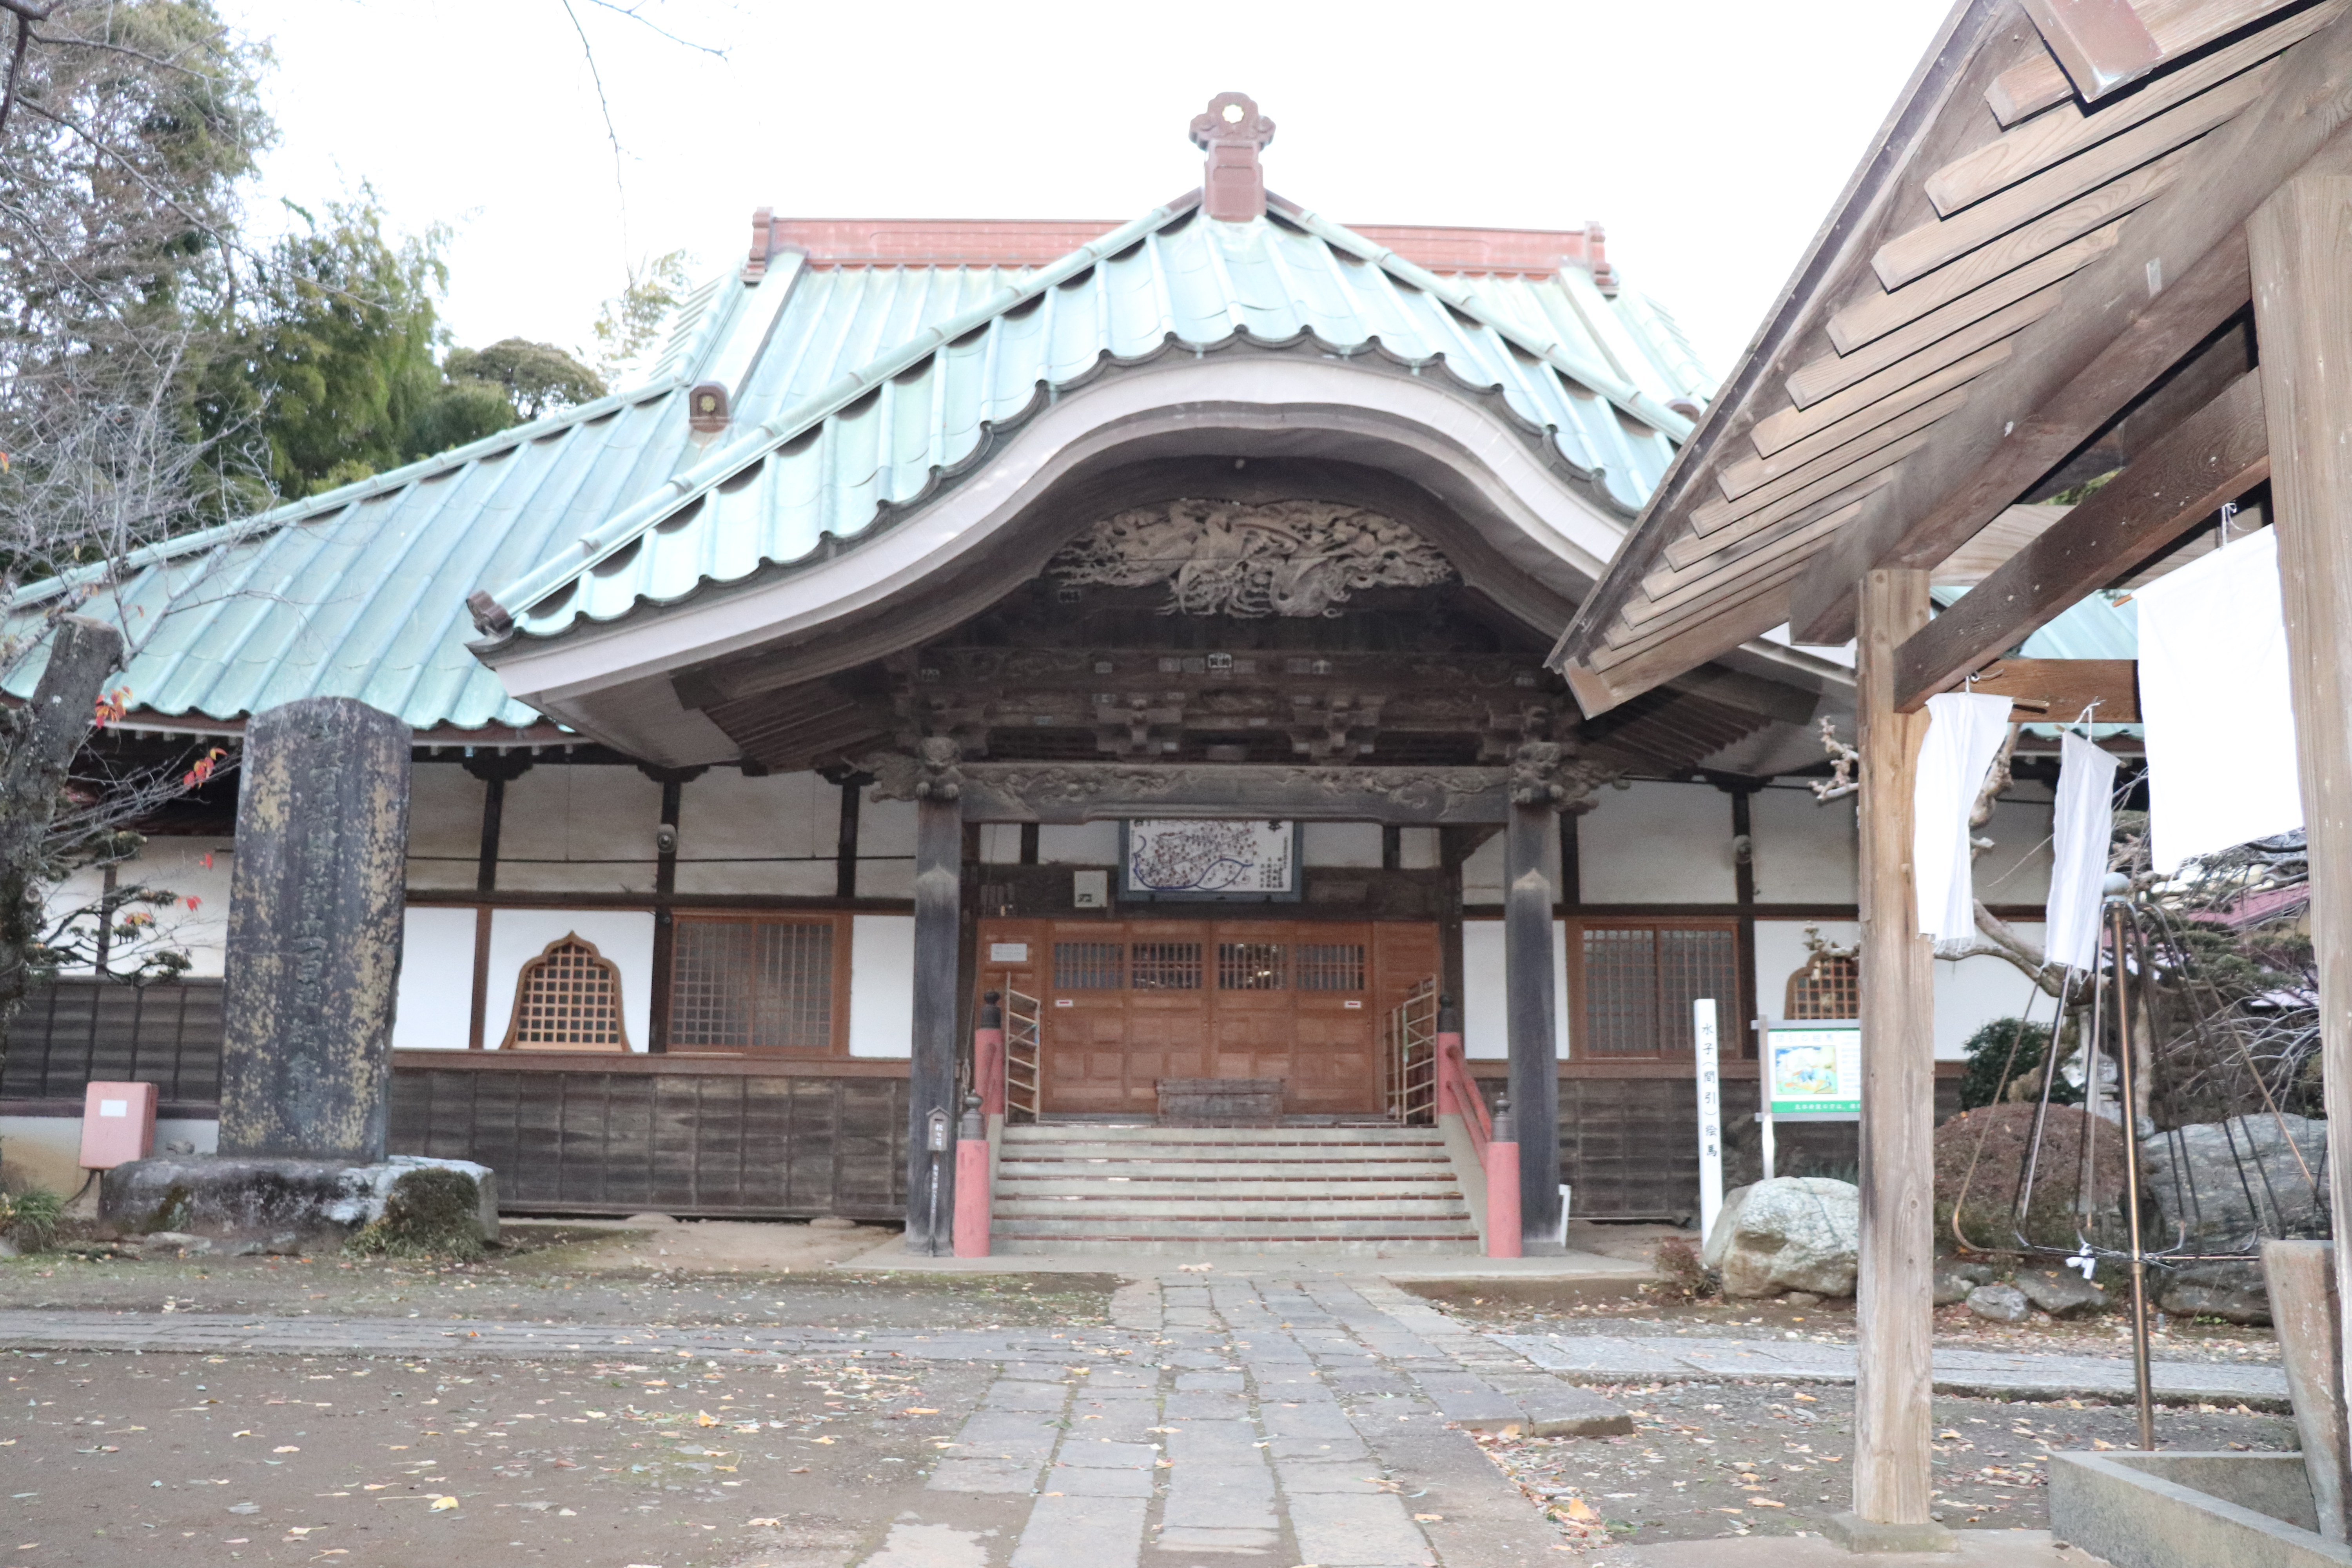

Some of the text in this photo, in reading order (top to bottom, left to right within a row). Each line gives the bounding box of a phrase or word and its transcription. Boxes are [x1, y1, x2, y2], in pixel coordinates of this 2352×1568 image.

[1775, 1033, 1834, 1042] 間引の絵馬
[1702, 1022, 1718, 1157] 水子（間引）絵馬
